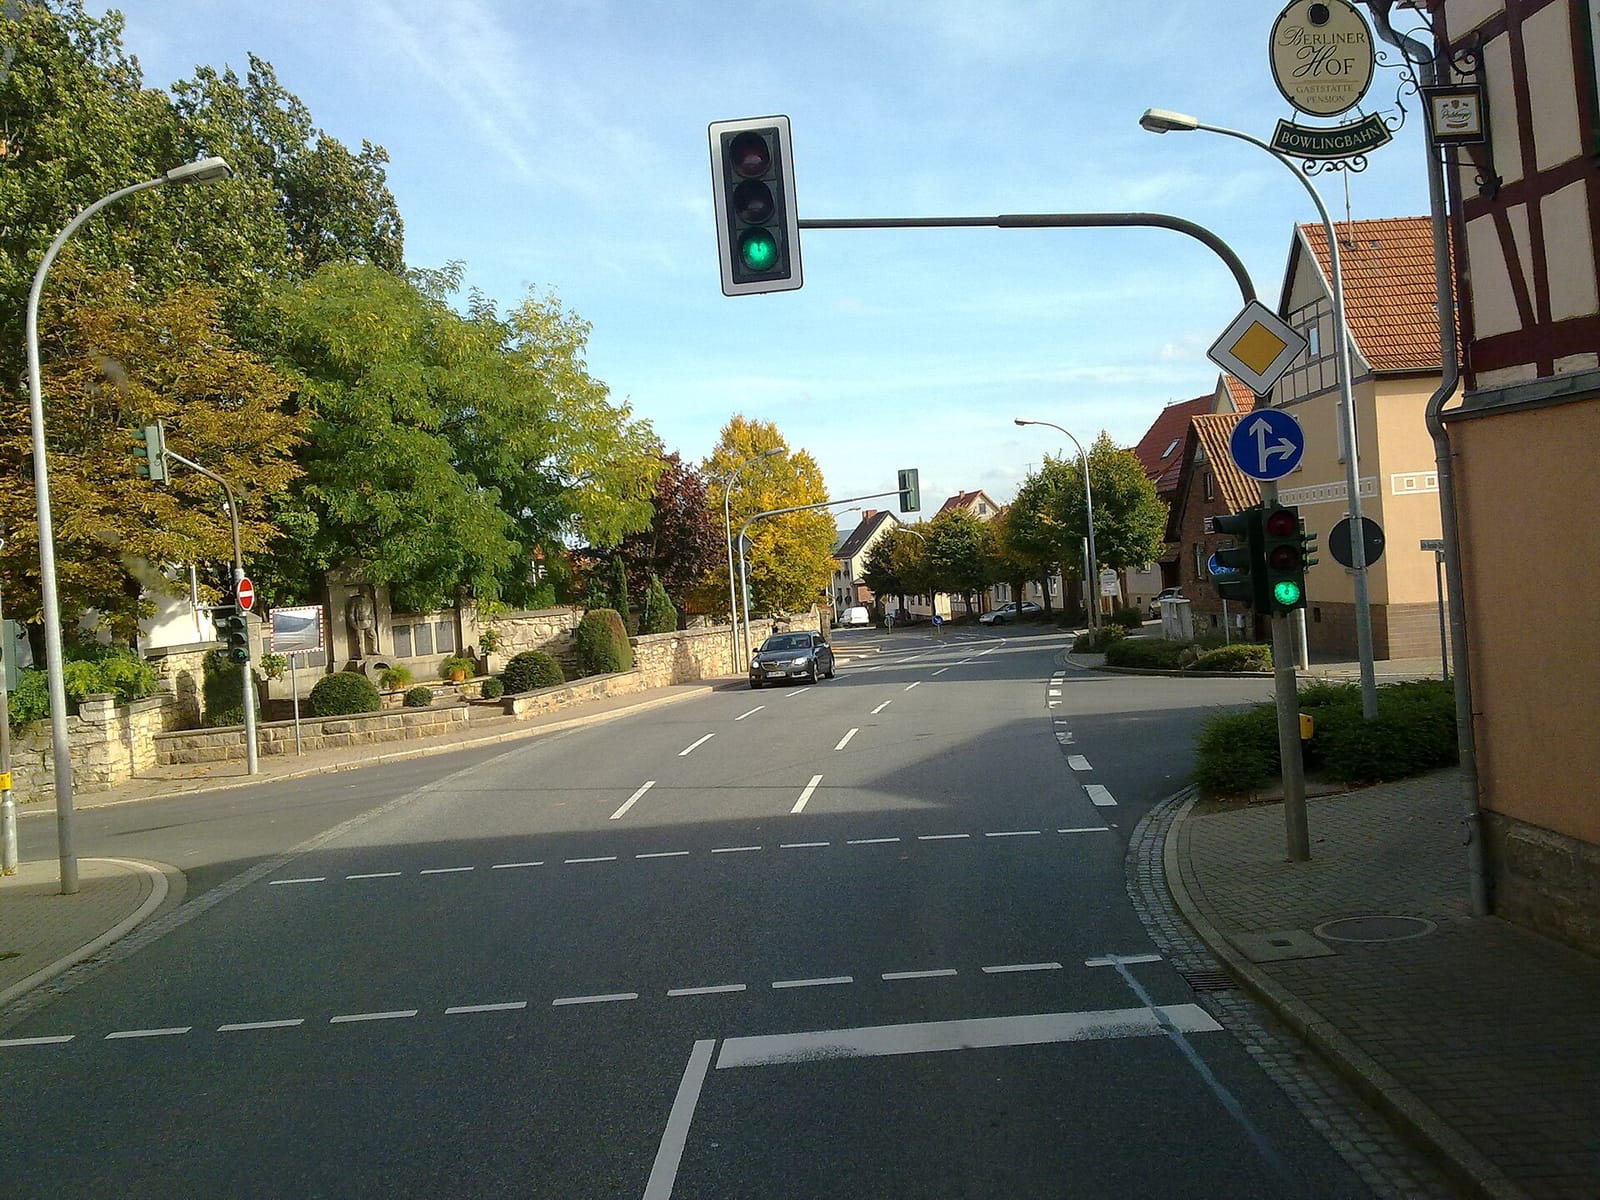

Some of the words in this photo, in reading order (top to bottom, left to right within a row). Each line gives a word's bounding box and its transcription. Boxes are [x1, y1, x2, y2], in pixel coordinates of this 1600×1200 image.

[1292, 45, 1355, 77] HOF
[1306, 94, 1345, 104] PENSION
[1281, 126, 1380, 150] BOWLINGBAHN
